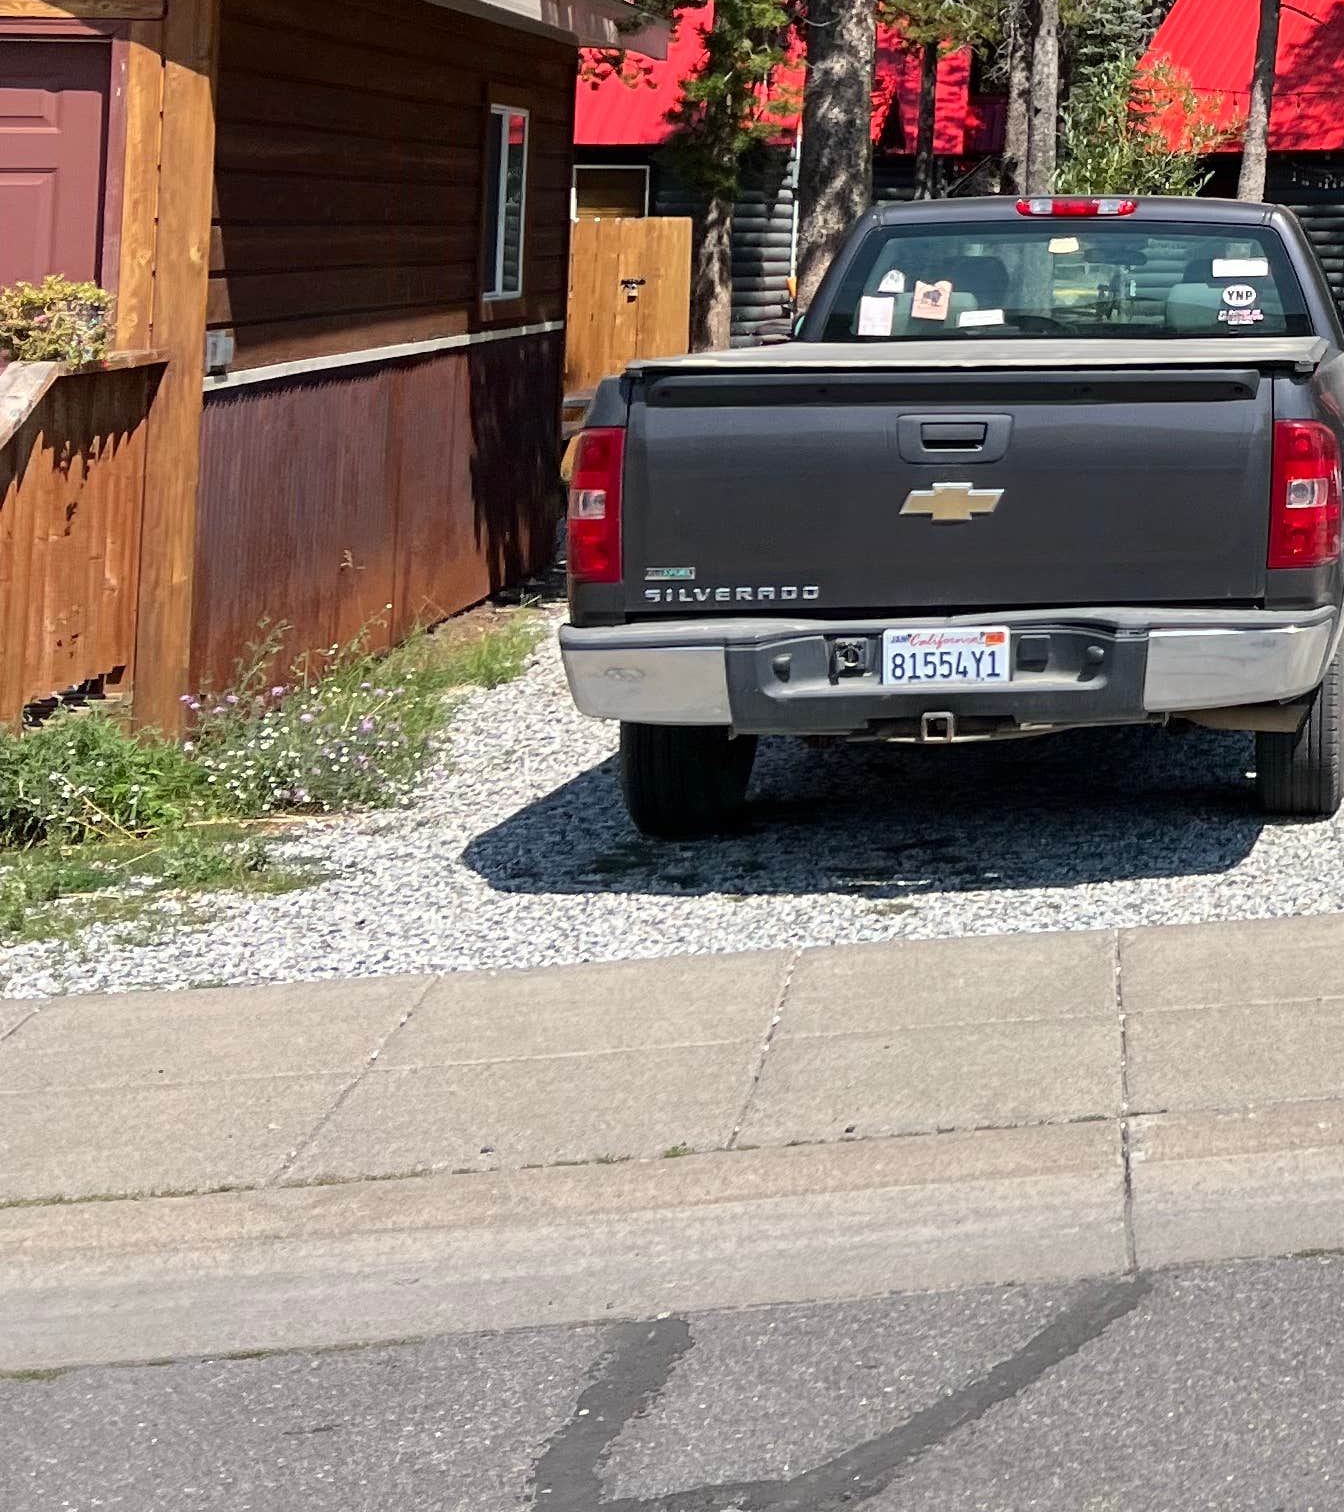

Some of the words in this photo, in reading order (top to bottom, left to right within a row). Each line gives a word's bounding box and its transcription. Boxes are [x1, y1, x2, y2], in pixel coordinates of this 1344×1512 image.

[1227, 290, 1253, 301] YNP
[644, 586, 820, 603] SILVERADO
[909, 632, 979, 649] California
[891, 650, 1001, 680] 81554Y1
